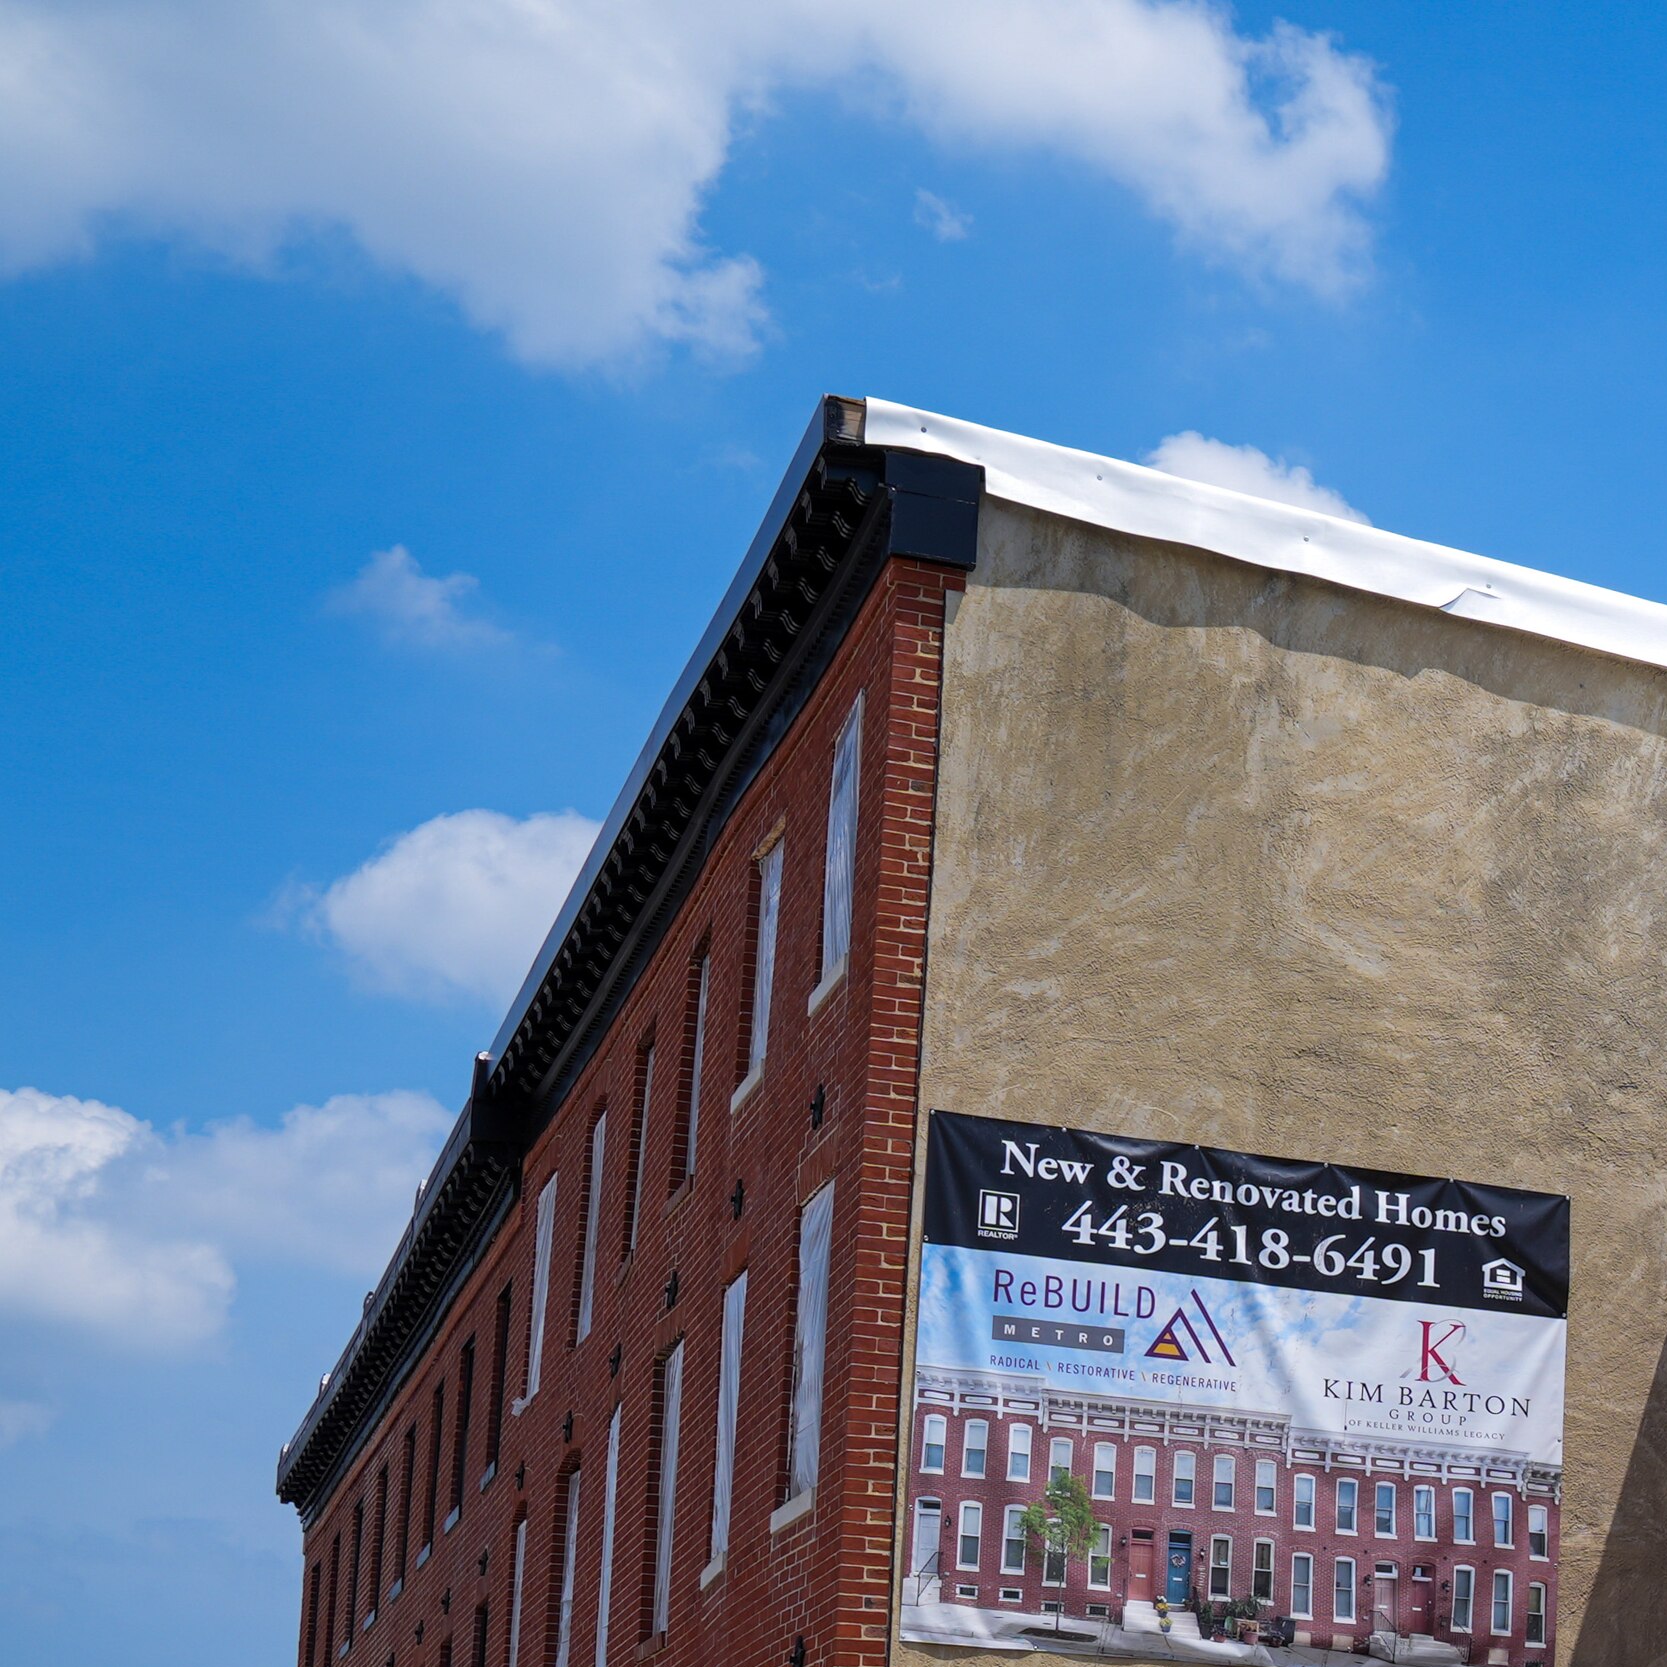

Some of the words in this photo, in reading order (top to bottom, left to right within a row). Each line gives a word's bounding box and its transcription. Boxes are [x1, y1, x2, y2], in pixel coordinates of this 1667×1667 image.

[1000, 1140, 1094, 1184] New
[1107, 1155, 1147, 1191] &
[1158, 1160, 1363, 1220] Renovated
[1374, 1190, 1507, 1238] Homes
[1061, 1200, 1441, 1288] 443-418-6491
[993, 1269, 1156, 1319] ReBUILD
[1483, 1293, 1523, 1302] OPPORTUNITY
[1004, 1324, 1114, 1346] METRO
[990, 1354, 1041, 1371] RADICAL
[1057, 1362, 1136, 1381] RESTORATIVE
[1152, 1372, 1237, 1392] REGENERATIVE
[1323, 1378, 1384, 1403] KIM
[1398, 1386, 1531, 1418] BARTON
[1389, 1408, 1468, 1426] GROUP
[1348, 1418, 1363, 1427] OF
[1366, 1420, 1404, 1431] KELLER
[1408, 1424, 1460, 1437] WILLIAMS
[1463, 1430, 1506, 1441] LEGACY
